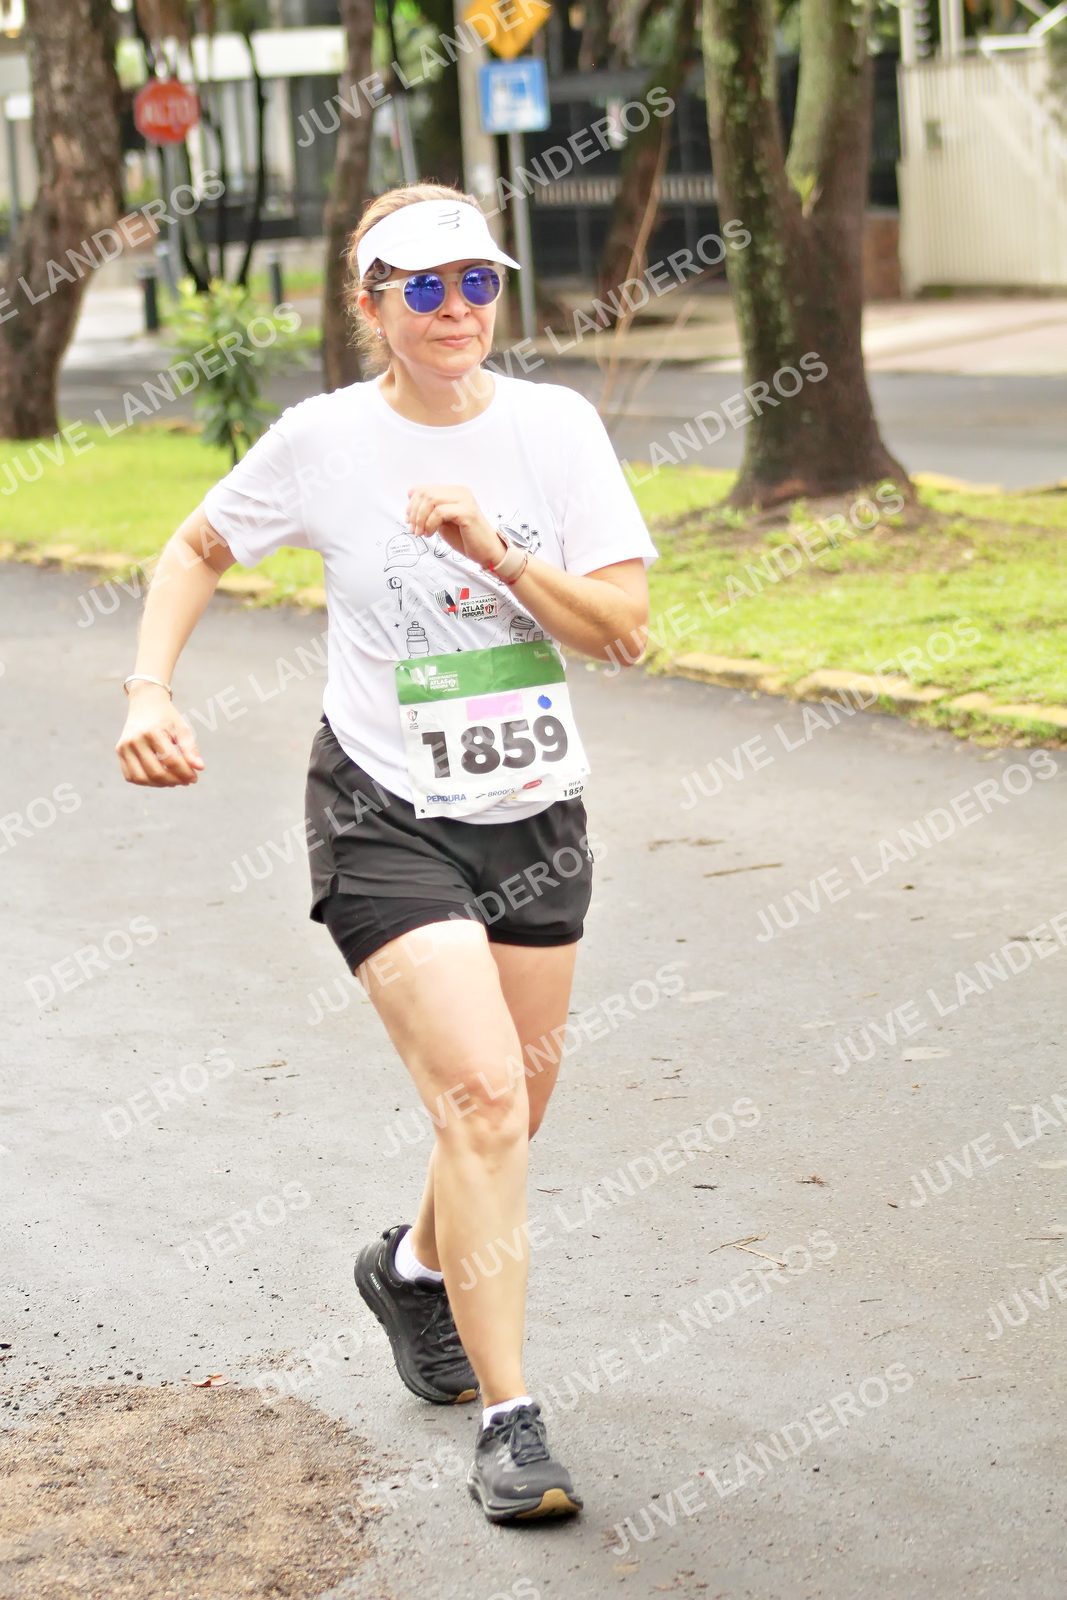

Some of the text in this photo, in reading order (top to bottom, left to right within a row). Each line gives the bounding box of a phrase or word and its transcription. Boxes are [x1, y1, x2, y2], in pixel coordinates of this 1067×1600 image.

[142, 97, 194, 126] ALTO
[462, 604, 484, 613] ATLAS
[421, 715, 568, 778] 1859
[563, 786, 584, 797] 1859
[426, 793, 467, 803] PERDURA
